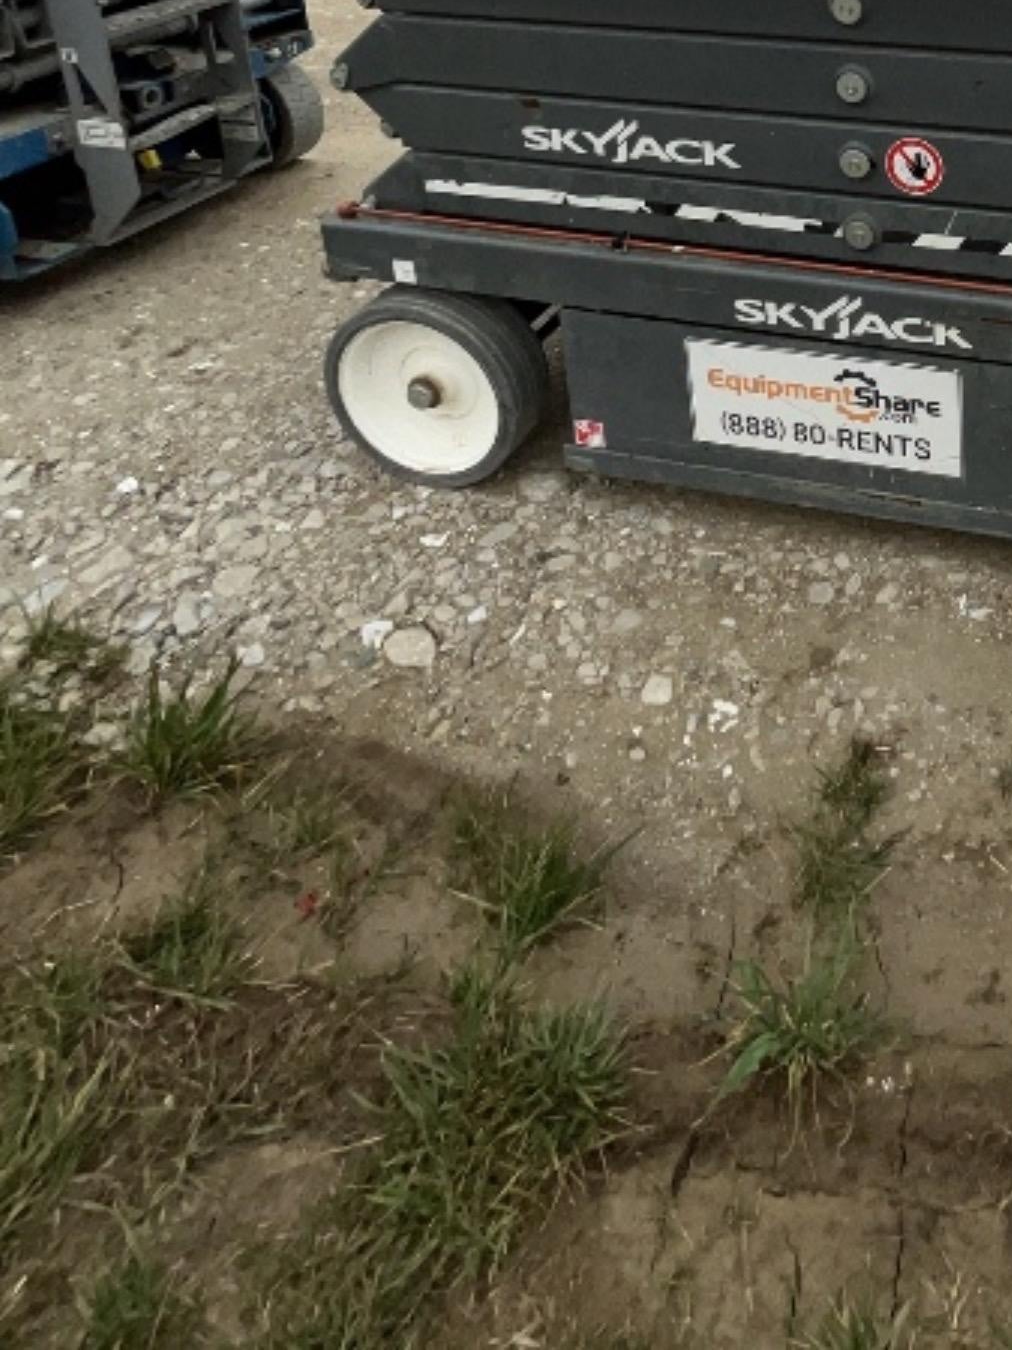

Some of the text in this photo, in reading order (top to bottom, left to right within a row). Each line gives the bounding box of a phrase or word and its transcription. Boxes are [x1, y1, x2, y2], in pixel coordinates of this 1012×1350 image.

[521, 118, 741, 169] SKYJACK
[734, 295, 973, 349] SKYJACK
[707, 368, 941, 418] EquipmentShare
[721, 410, 932, 461] (888) 80-RENTS
